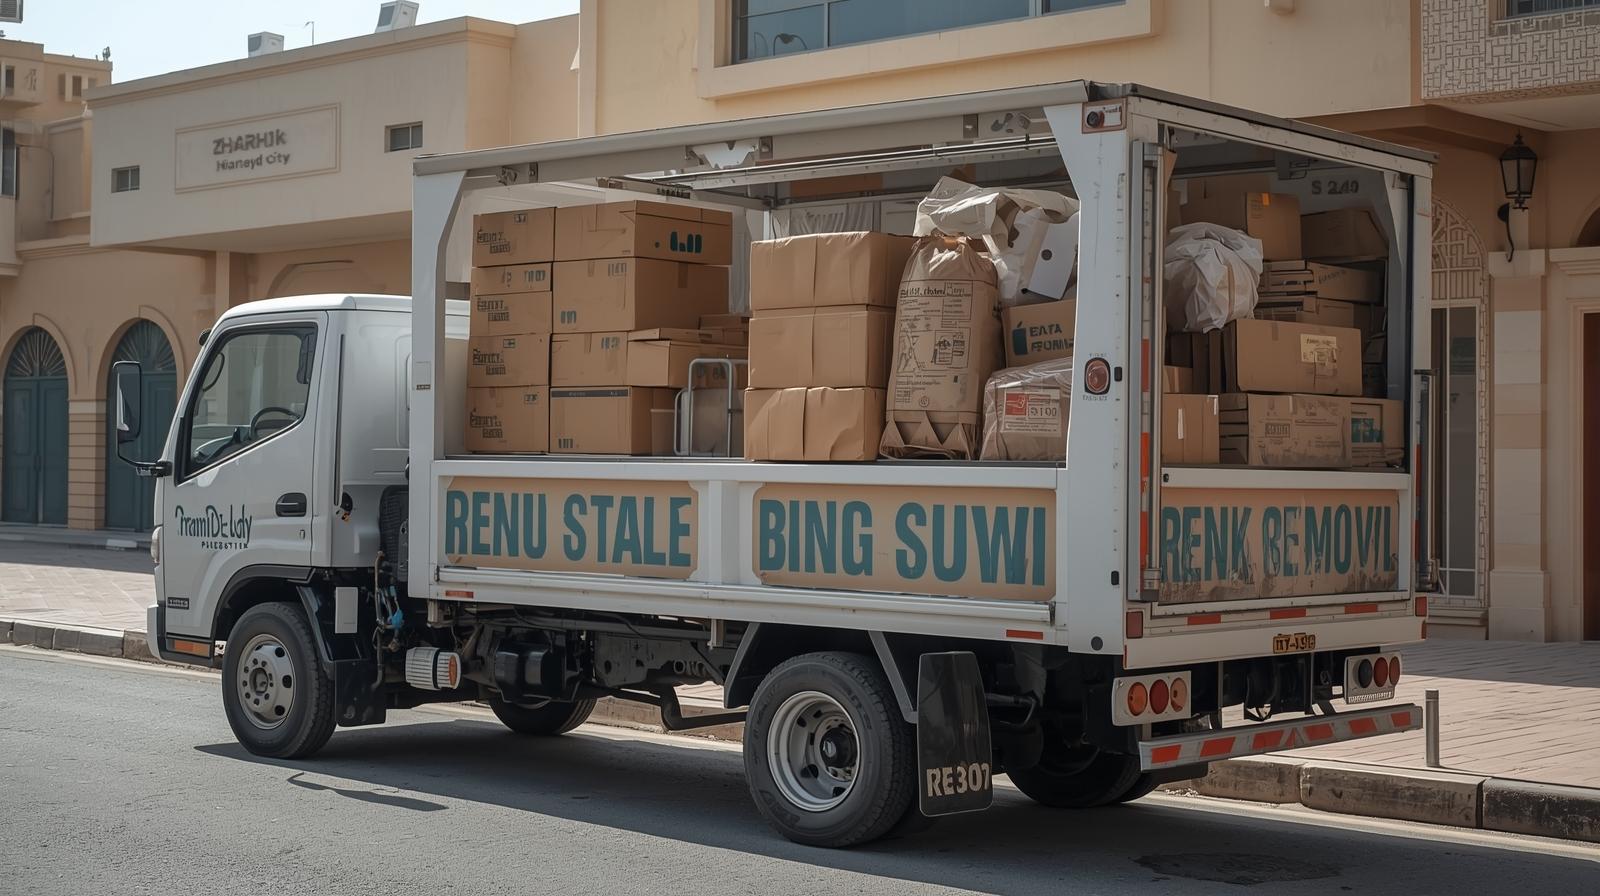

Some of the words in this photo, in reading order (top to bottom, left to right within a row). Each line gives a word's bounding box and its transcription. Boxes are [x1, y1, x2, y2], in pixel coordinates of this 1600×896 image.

[445, 490, 547, 559] RENU
[563, 493, 692, 567] STALE
[759, 499, 873, 576] BING
[895, 502, 1046, 586] SUWI
[1161, 505, 1254, 585] RENK
